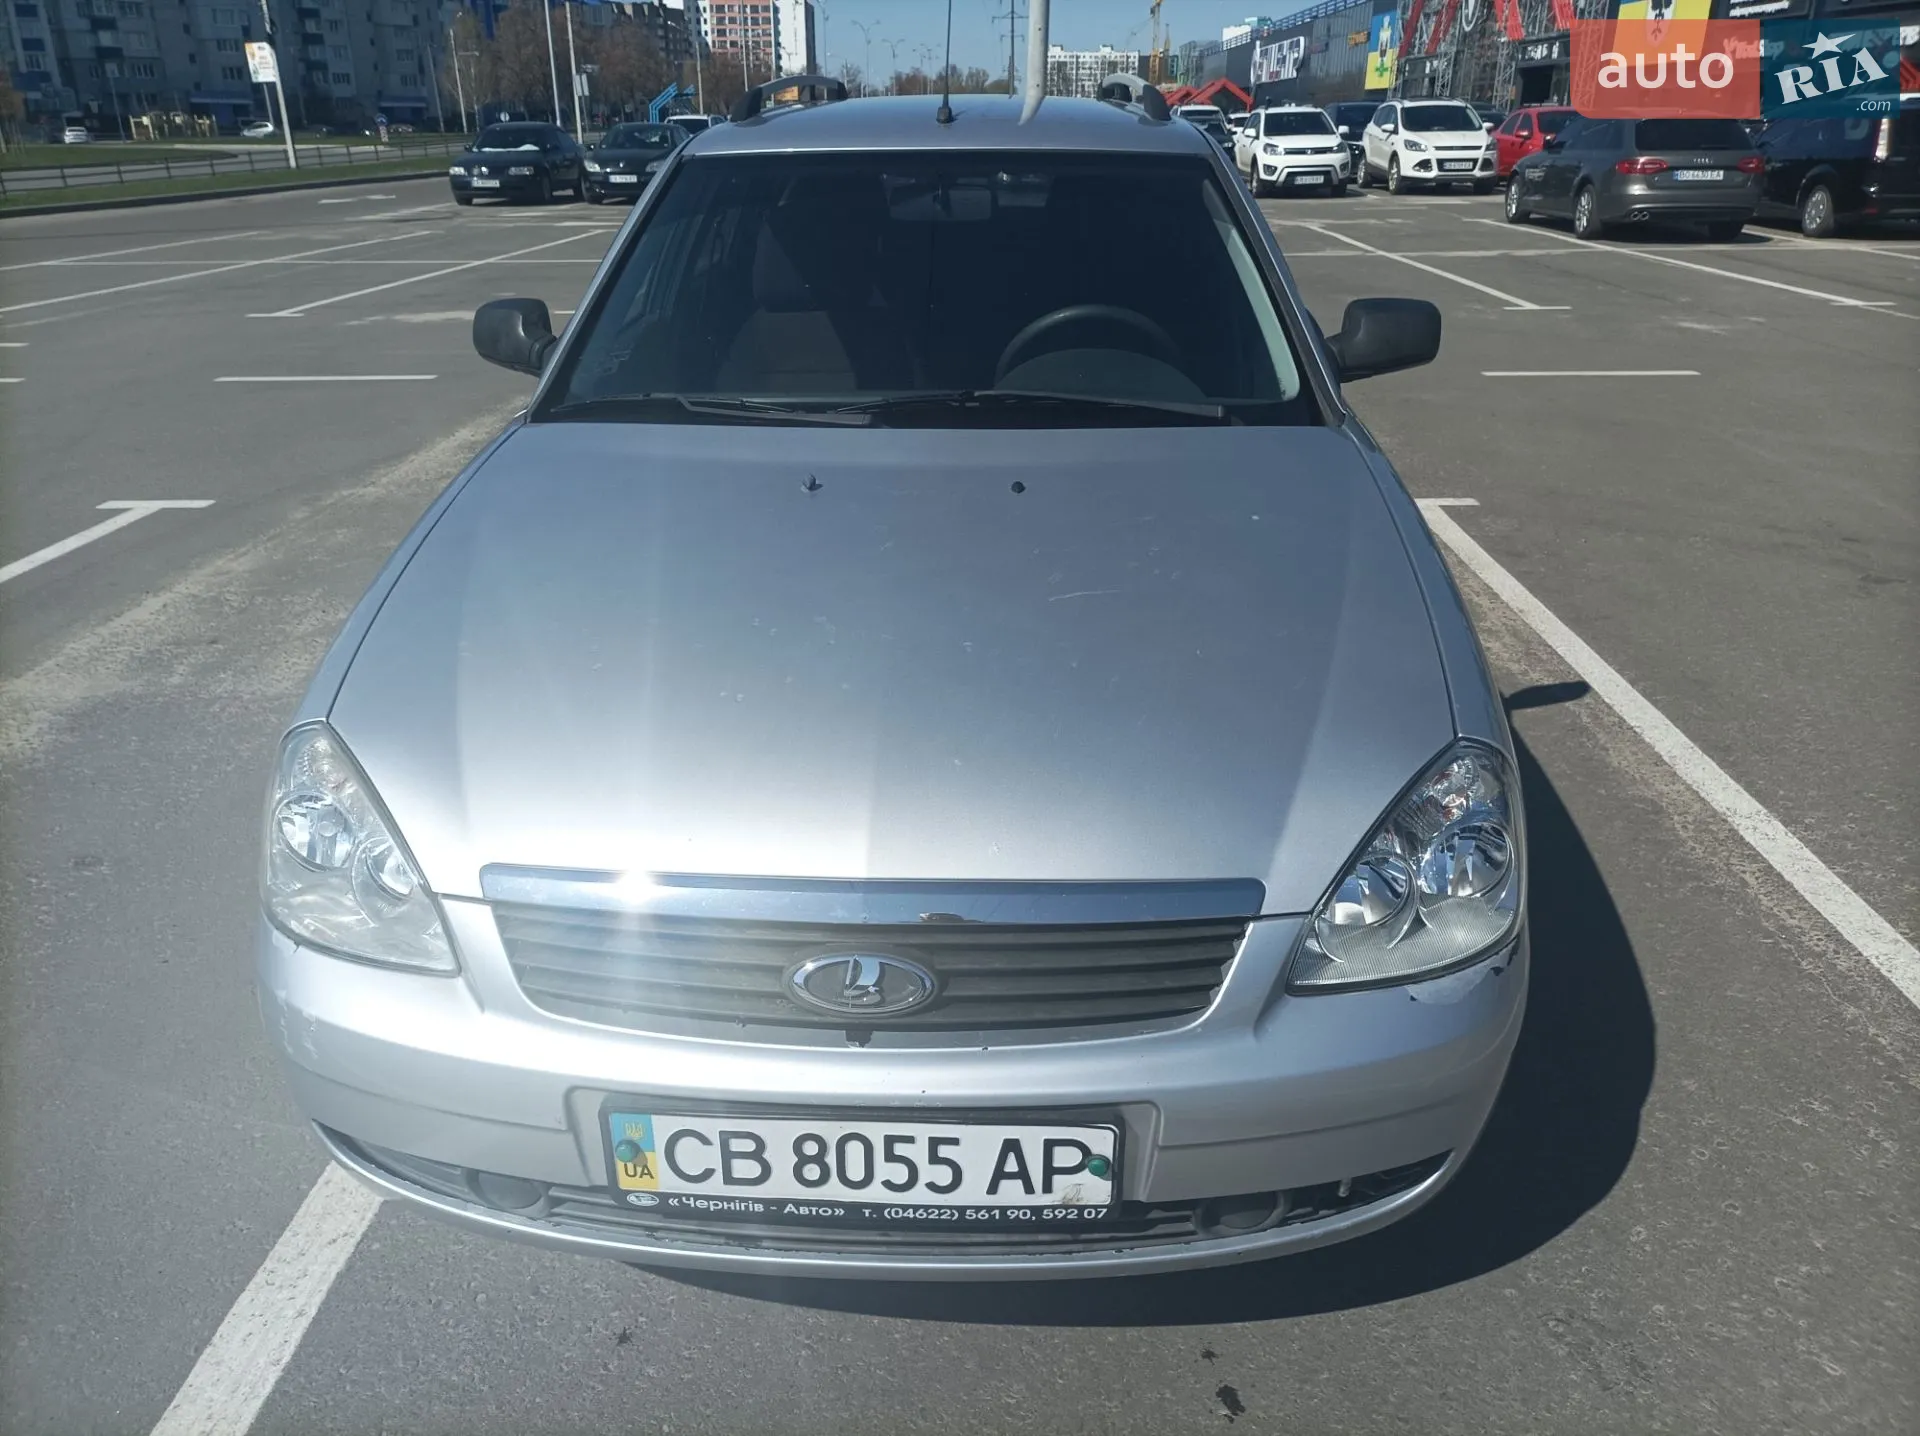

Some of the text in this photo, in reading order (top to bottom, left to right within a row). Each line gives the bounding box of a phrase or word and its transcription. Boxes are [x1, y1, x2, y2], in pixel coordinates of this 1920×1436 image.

[624, 1163, 655, 1180] UA
[664, 1128, 1092, 1195] CB 8055 AP
[668, 1196, 765, 1213] «Чернігів
[783, 1203, 846, 1217] Авто»
[883, 1207, 959, 1221] (04622)
[965, 1208, 1000, 1220] 561
[1006, 1208, 1036, 1221] 90,
[1042, 1208, 1078, 1220] 592
[1083, 1207, 1108, 1220] 07
